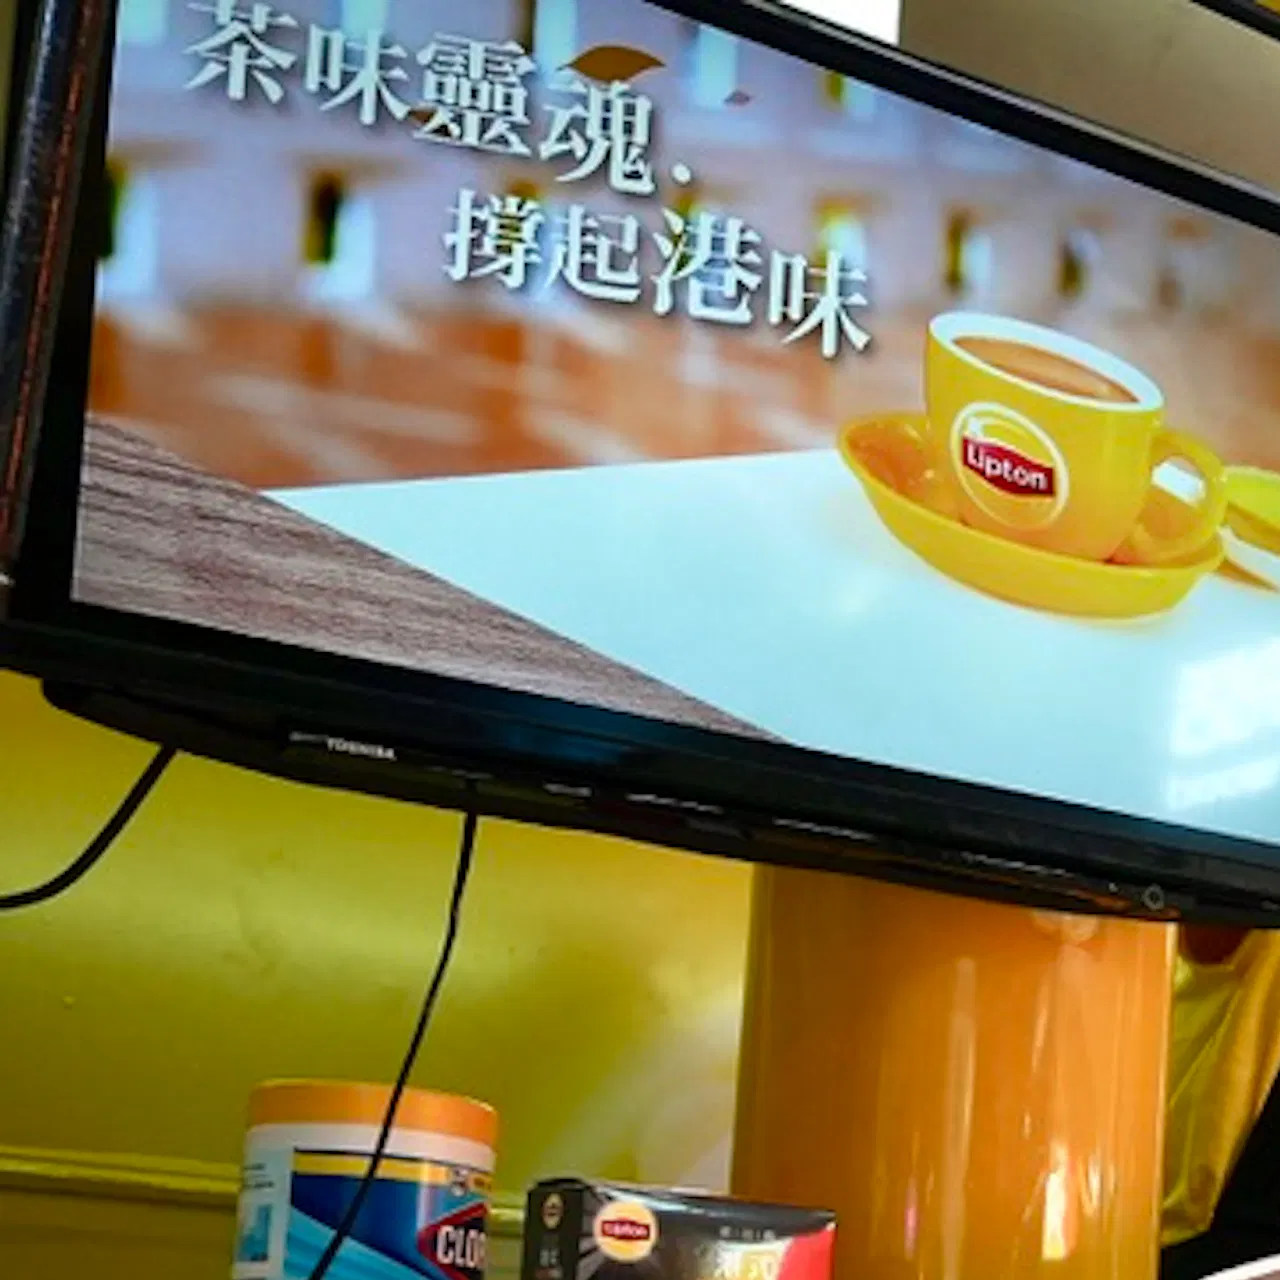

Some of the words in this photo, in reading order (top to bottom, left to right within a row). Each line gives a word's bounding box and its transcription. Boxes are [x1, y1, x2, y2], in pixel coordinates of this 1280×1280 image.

[443, 187, 872, 358] 撐起港味
[966, 443, 1049, 491] Lipton
